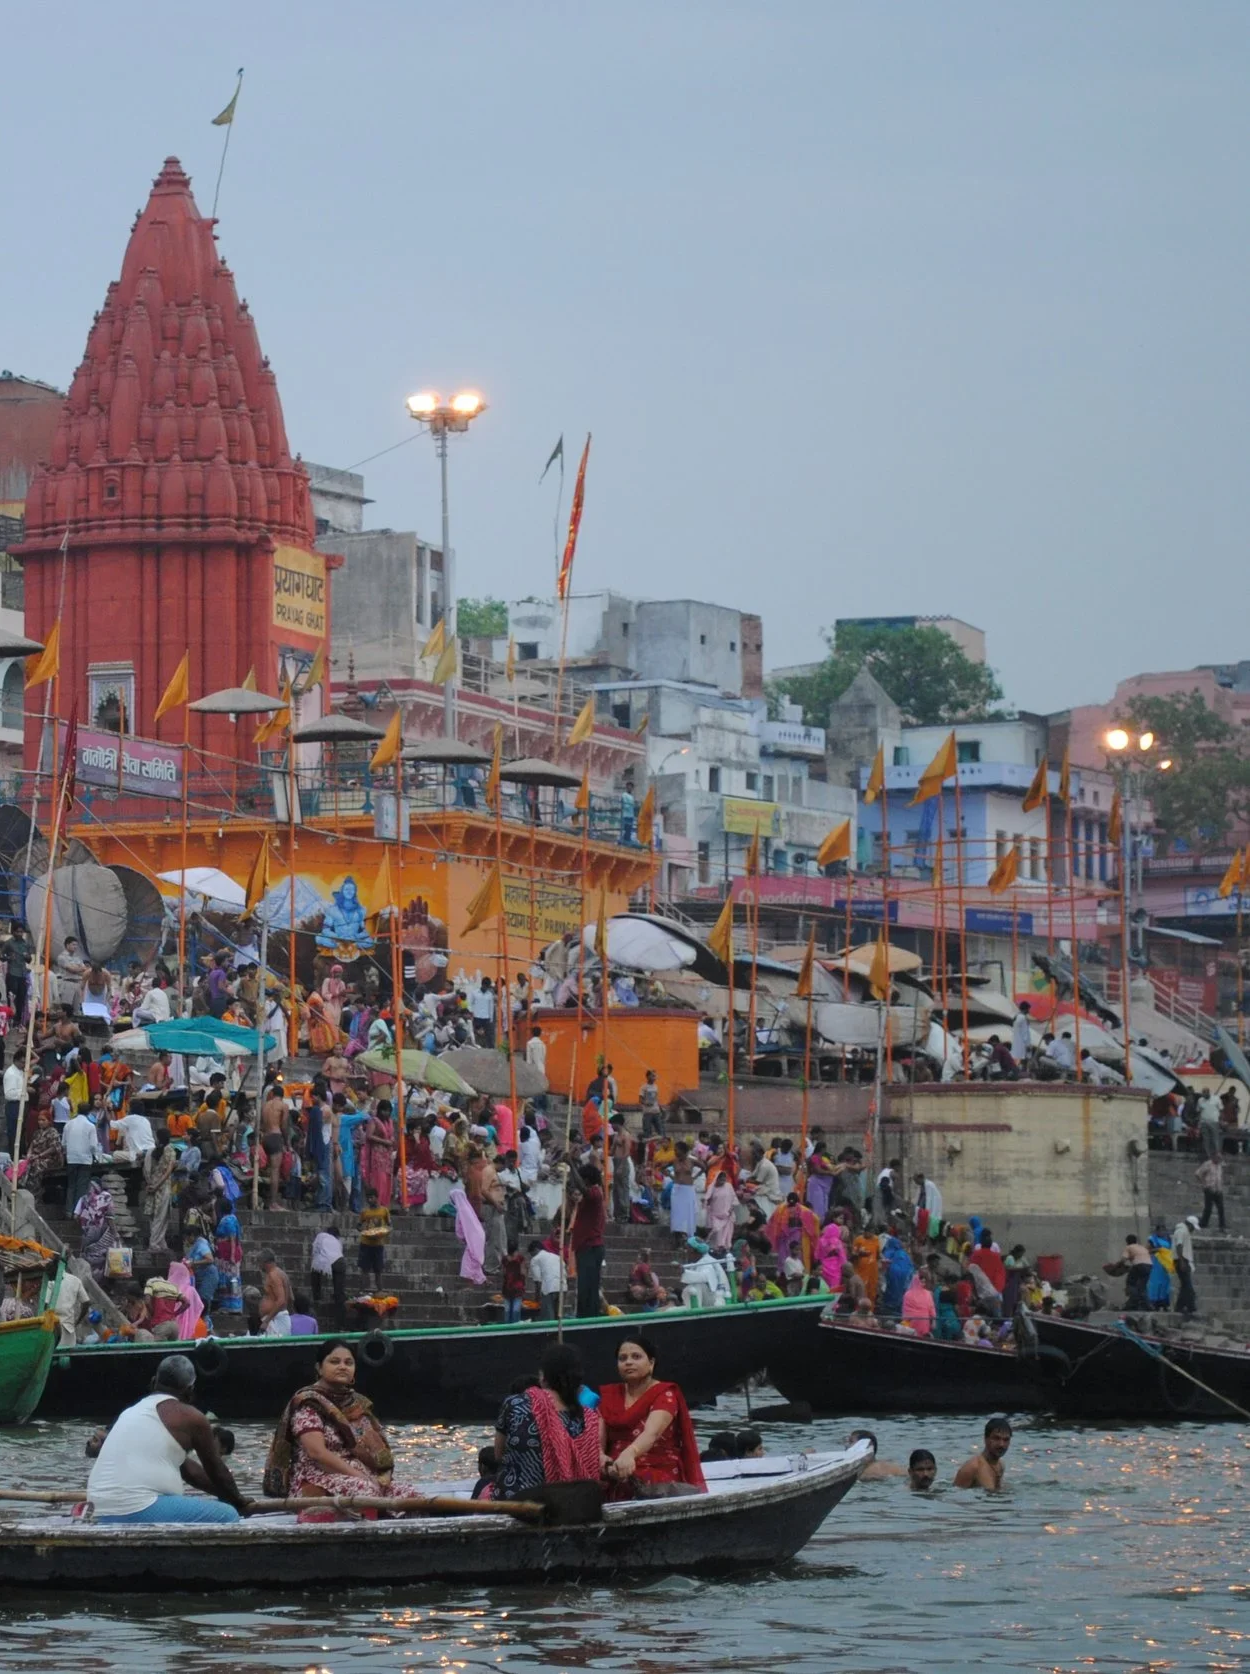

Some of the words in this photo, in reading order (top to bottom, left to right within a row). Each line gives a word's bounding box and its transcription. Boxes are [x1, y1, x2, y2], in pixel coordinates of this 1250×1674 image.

[276, 603, 304, 626] PRAYAG
[305, 611, 325, 631] GHAT
[141, 756, 177, 782] समिति
